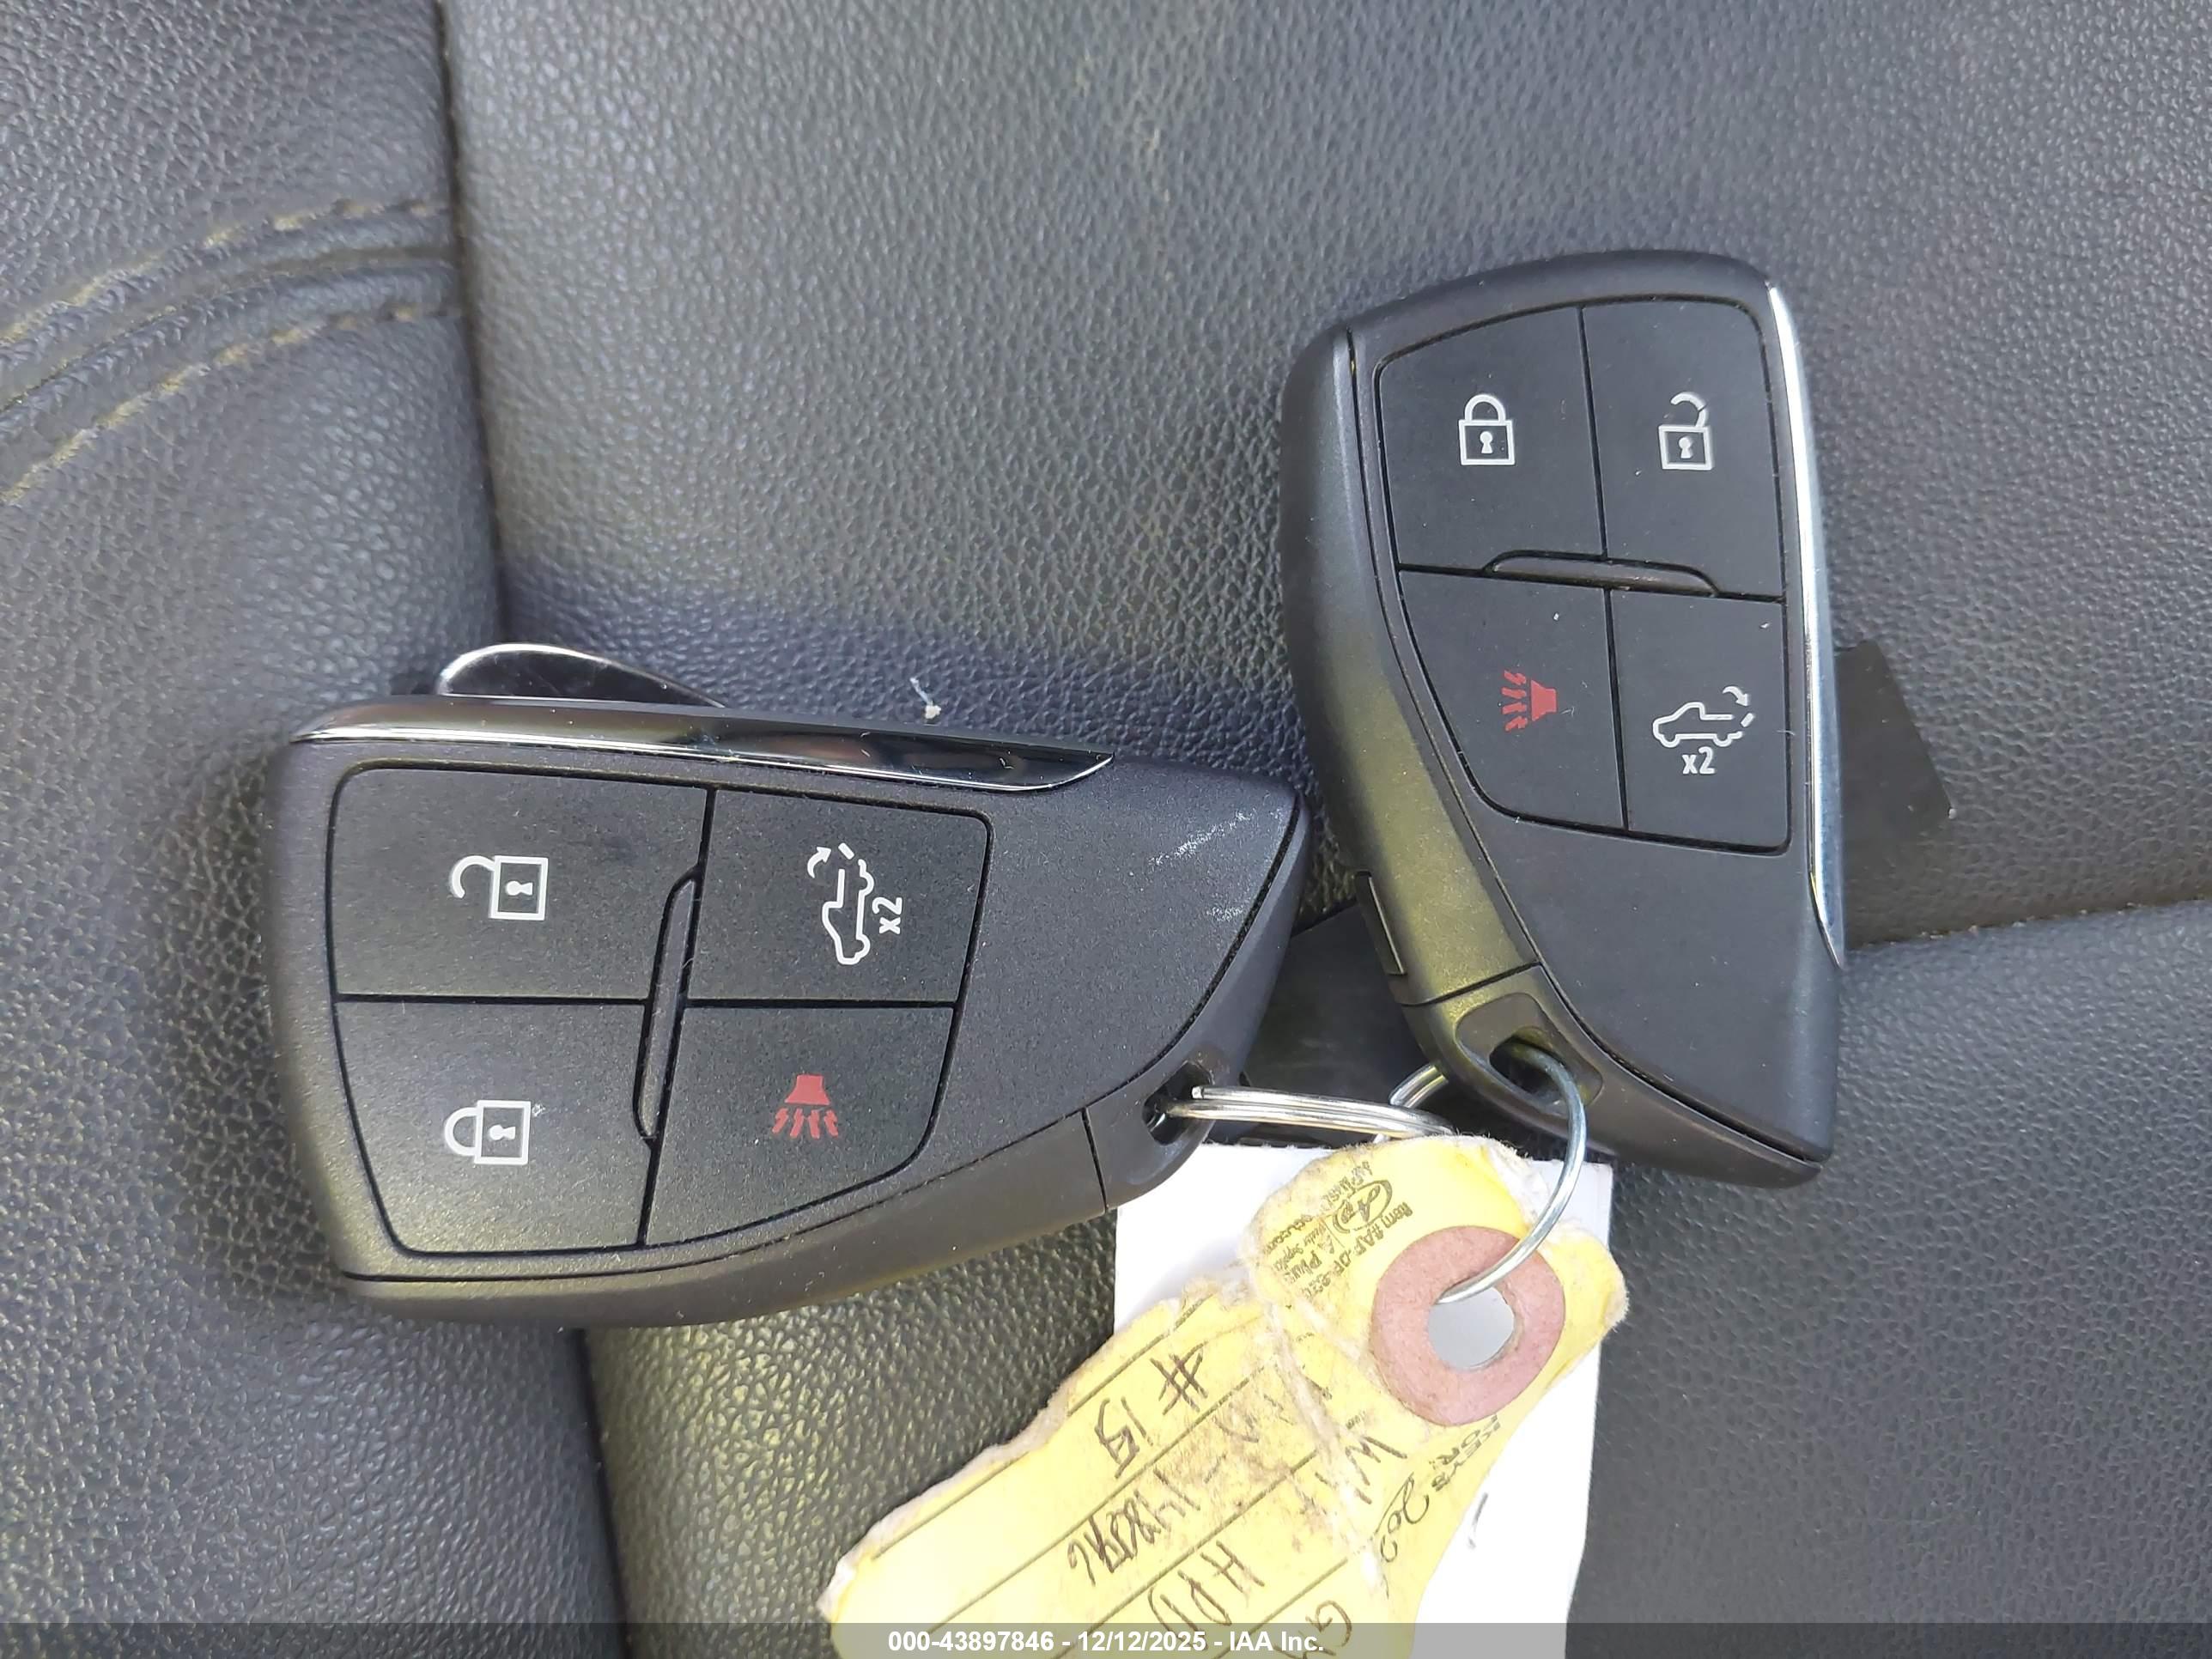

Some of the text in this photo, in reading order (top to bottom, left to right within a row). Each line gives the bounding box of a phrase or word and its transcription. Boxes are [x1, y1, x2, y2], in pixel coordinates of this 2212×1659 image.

[1681, 746, 1716, 775] x2
[872, 896, 903, 935] x2
[1383, 1201, 1413, 1229] Item
[1149, 1340, 1209, 1416] #
[1431, 1420, 1502, 1492] KEYS
